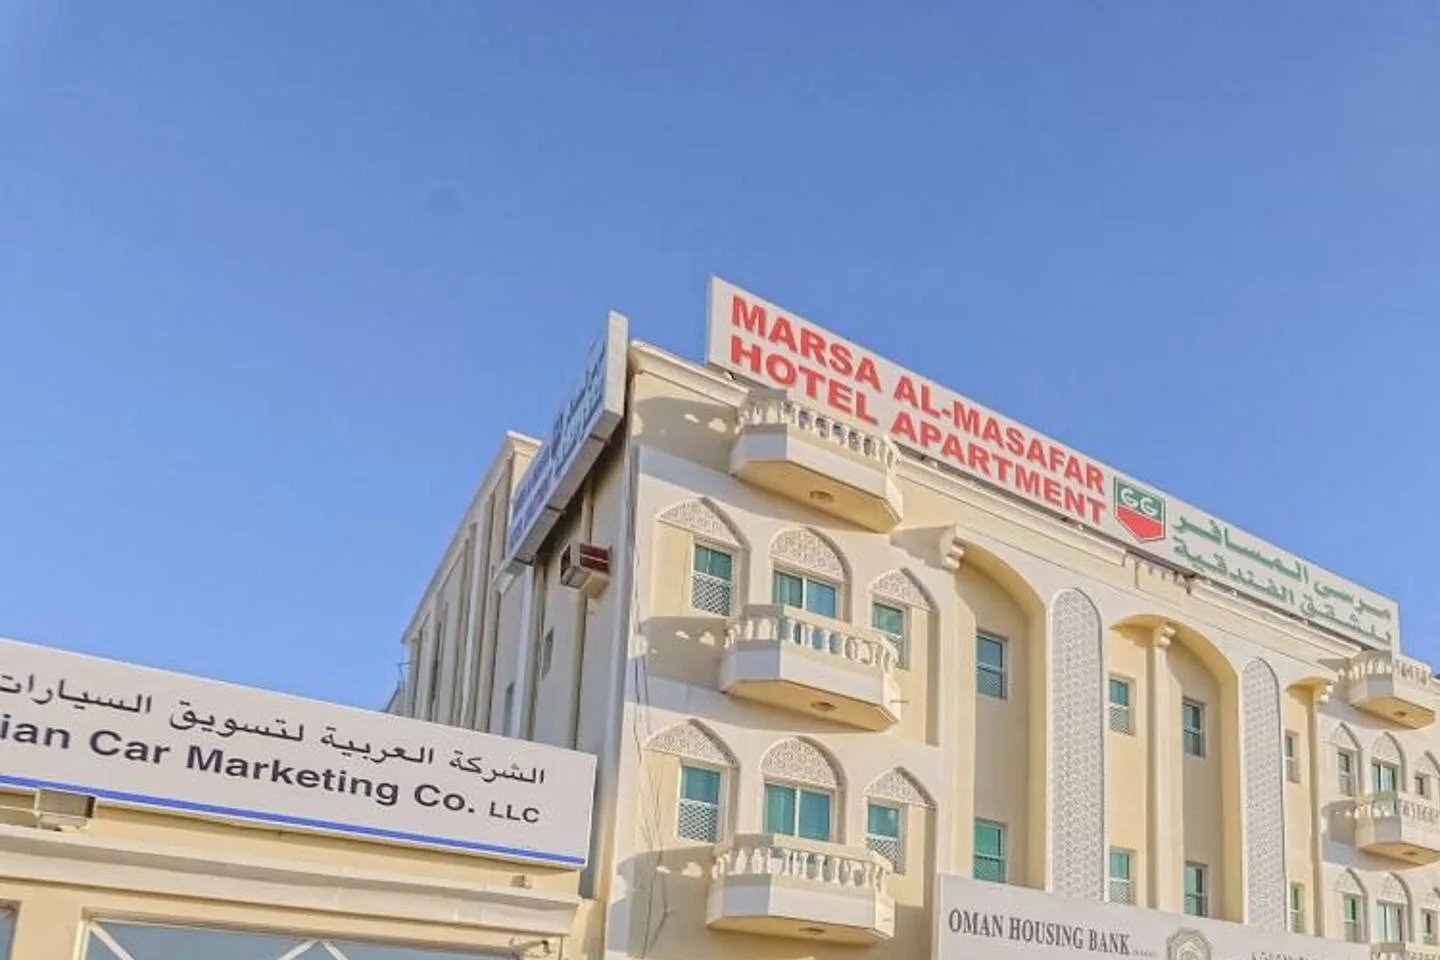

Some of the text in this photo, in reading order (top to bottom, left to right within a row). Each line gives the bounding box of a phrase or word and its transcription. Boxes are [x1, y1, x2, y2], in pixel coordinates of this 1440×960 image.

[730, 335, 1106, 524] HOTEL APARTMENT
[732, 294, 1105, 495] MARSA AL-MASAFAR
[1172, 514, 1309, 585] المسافر
[1172, 534, 1296, 605] الفندقية
[0, 673, 545, 783] الشركة العربية لتسويق السيارات
[88, 730, 170, 765] Car
[186, 744, 399, 806] Marketing
[414, 784, 475, 813] Co.
[488, 801, 540, 823] LLC
[948, 908, 1132, 956] OMAN HOUSING BANK
